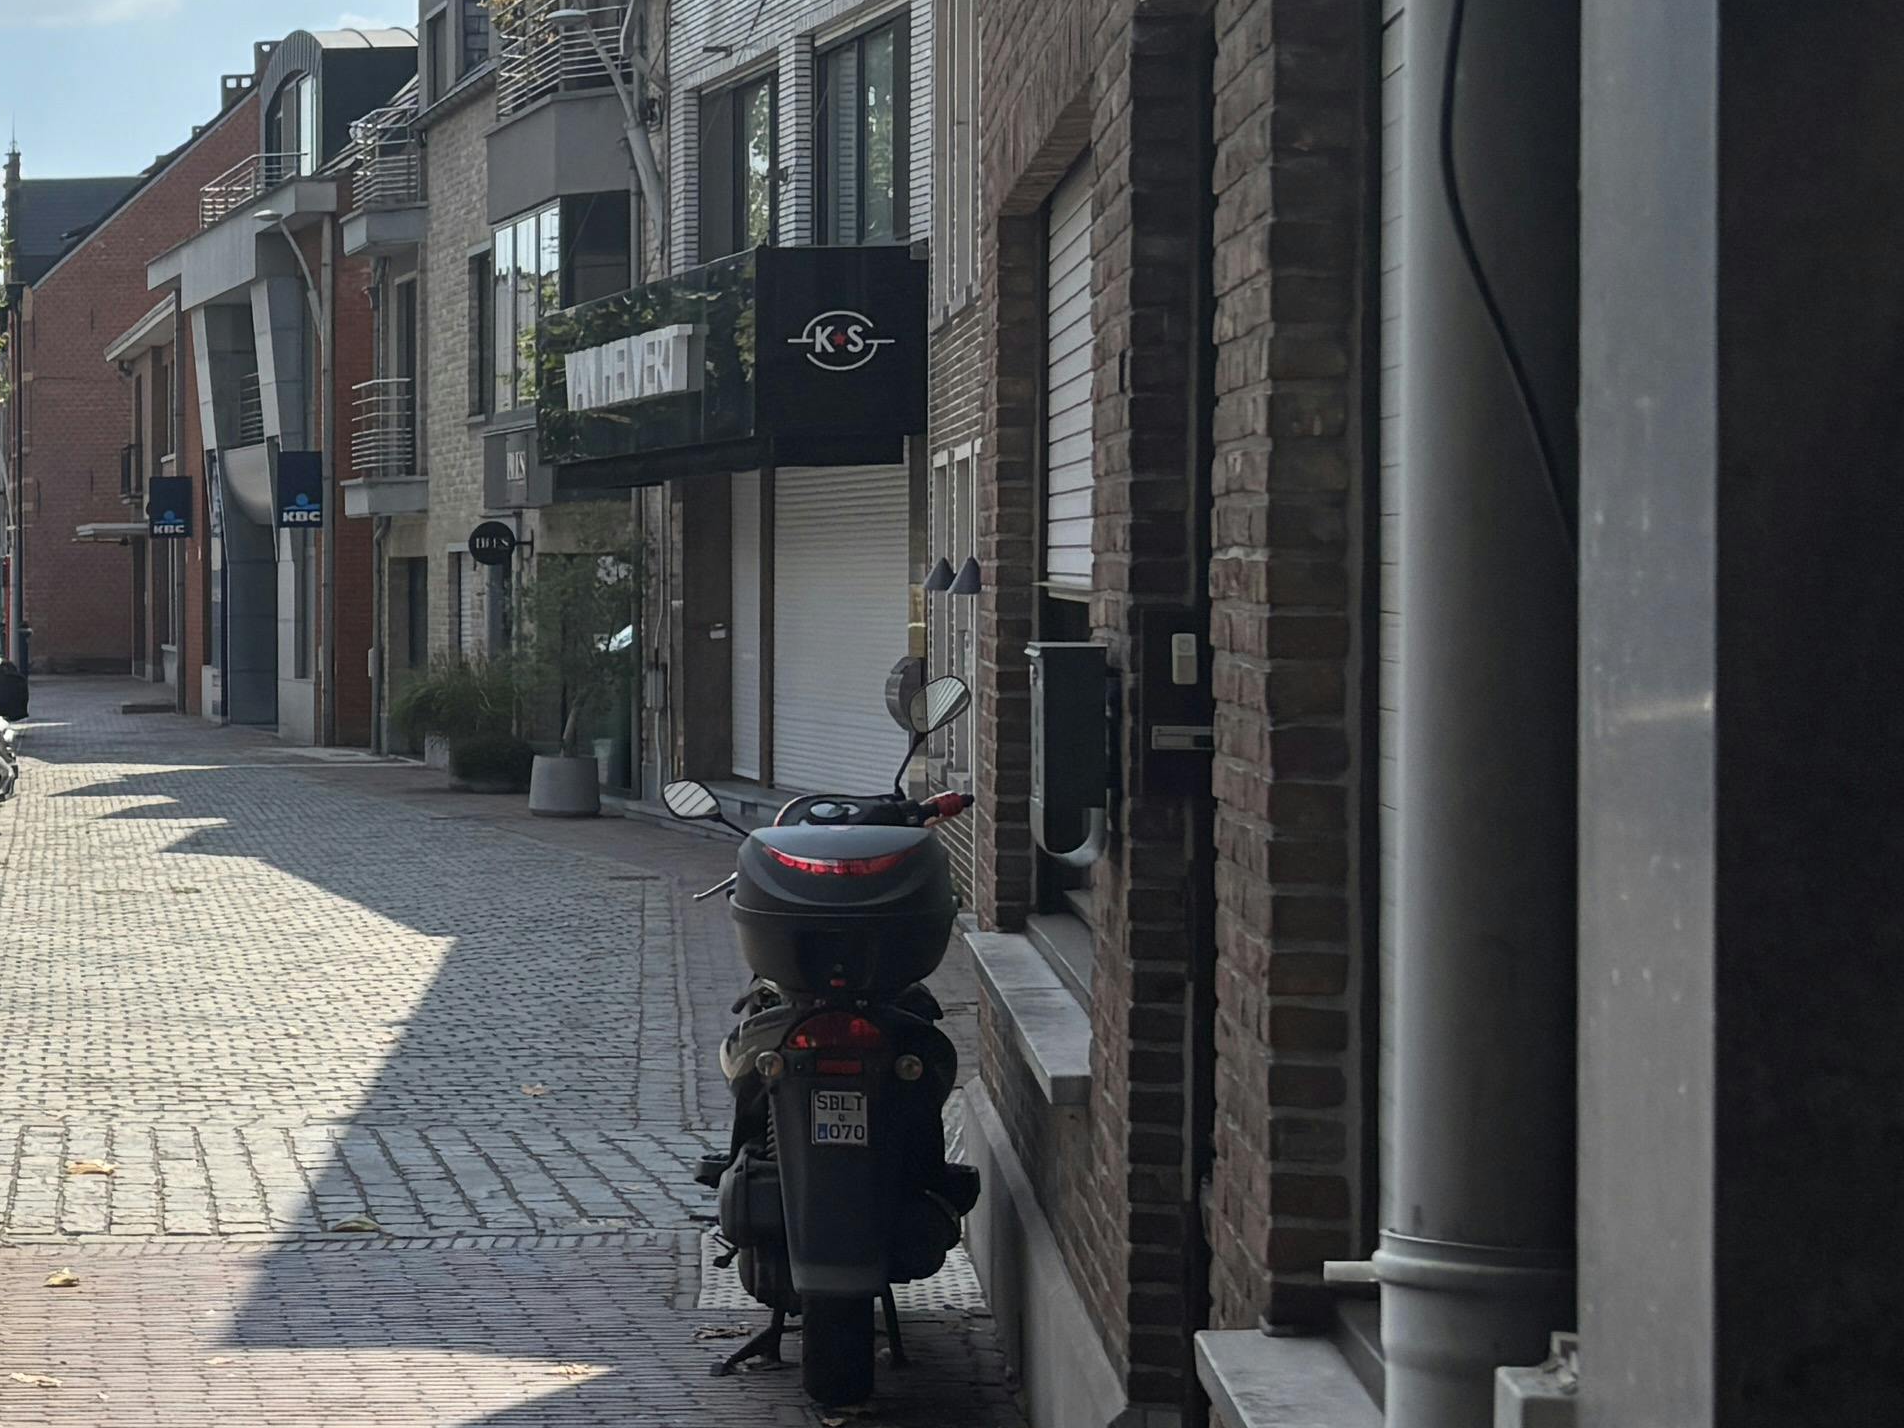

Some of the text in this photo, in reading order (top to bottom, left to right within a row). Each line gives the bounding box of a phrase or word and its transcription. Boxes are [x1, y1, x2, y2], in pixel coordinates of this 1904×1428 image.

[565, 347, 600, 411] VAN
[281, 511, 321, 523] KBC
[153, 524, 186, 534] KBC
[829, 1124, 865, 1141] 070
